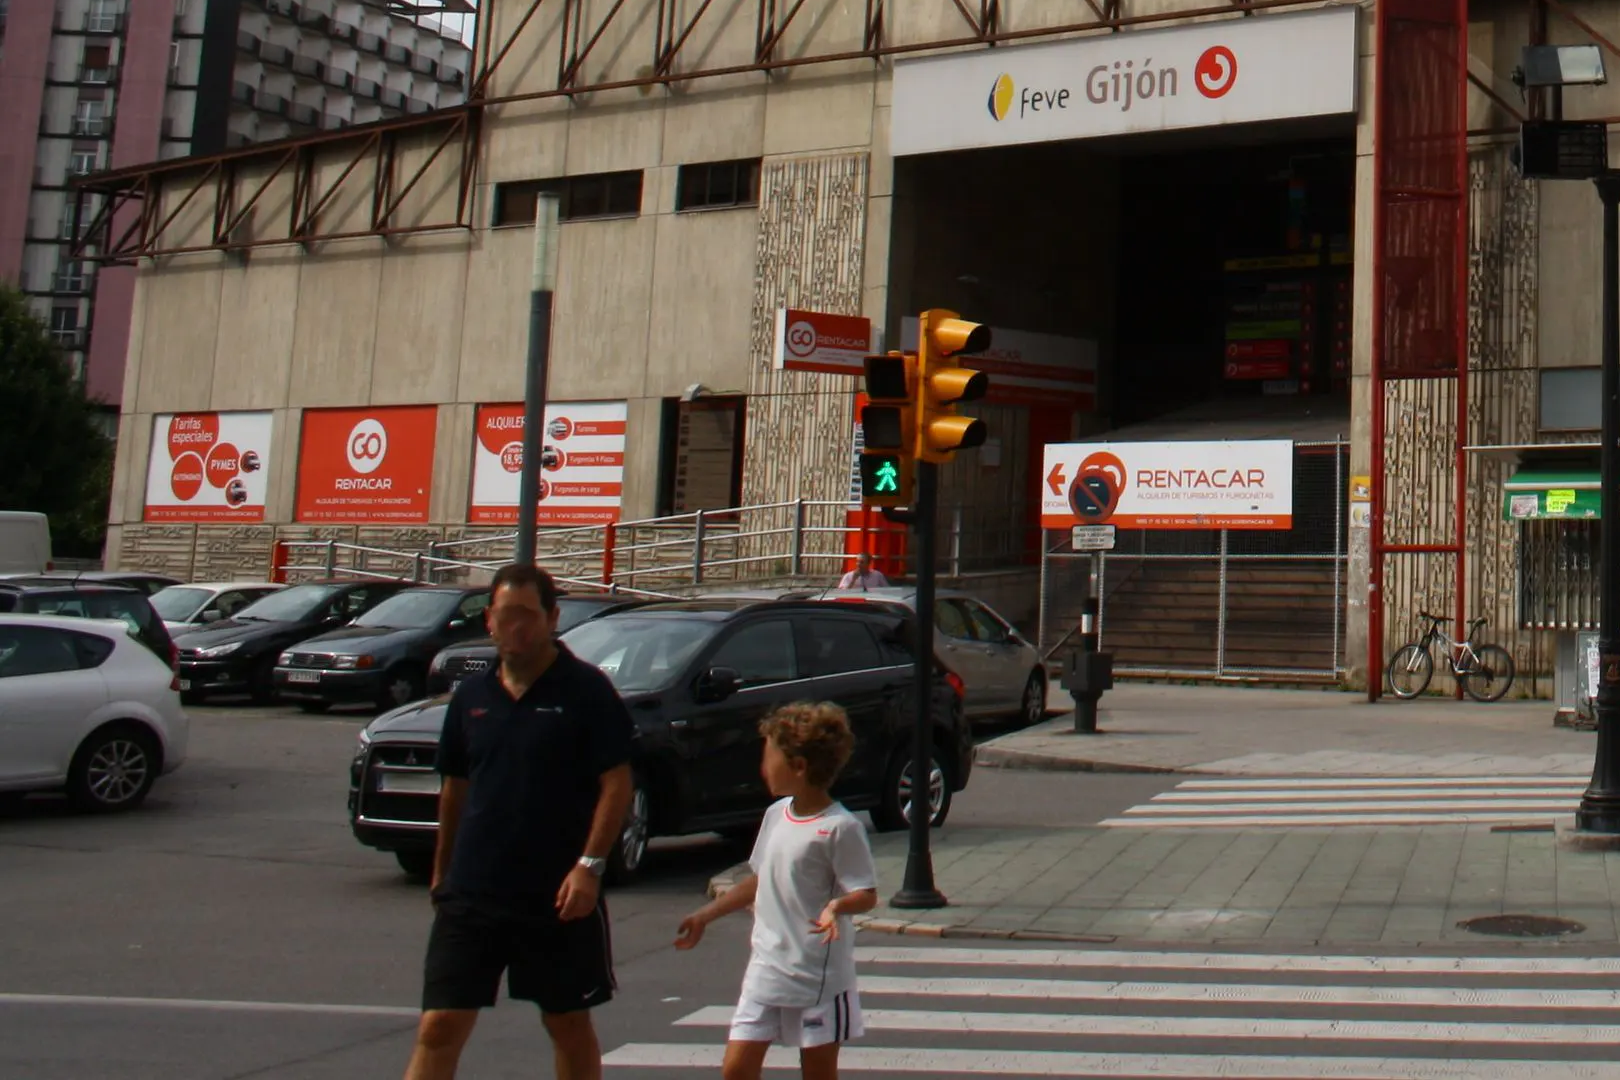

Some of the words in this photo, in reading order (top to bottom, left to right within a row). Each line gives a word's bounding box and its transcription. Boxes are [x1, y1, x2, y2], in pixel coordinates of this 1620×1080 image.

[1021, 88, 1070, 119] feve
[1086, 58, 1178, 112] Gijón
[816, 335, 867, 348] RENTACAR
[174, 417, 201, 430] Tarifas
[172, 431, 213, 445] especiales
[352, 432, 382, 460] GO
[211, 459, 236, 470] PYMES
[335, 478, 391, 490] RENTACAR
[1136, 469, 1265, 489] RENTACAR
